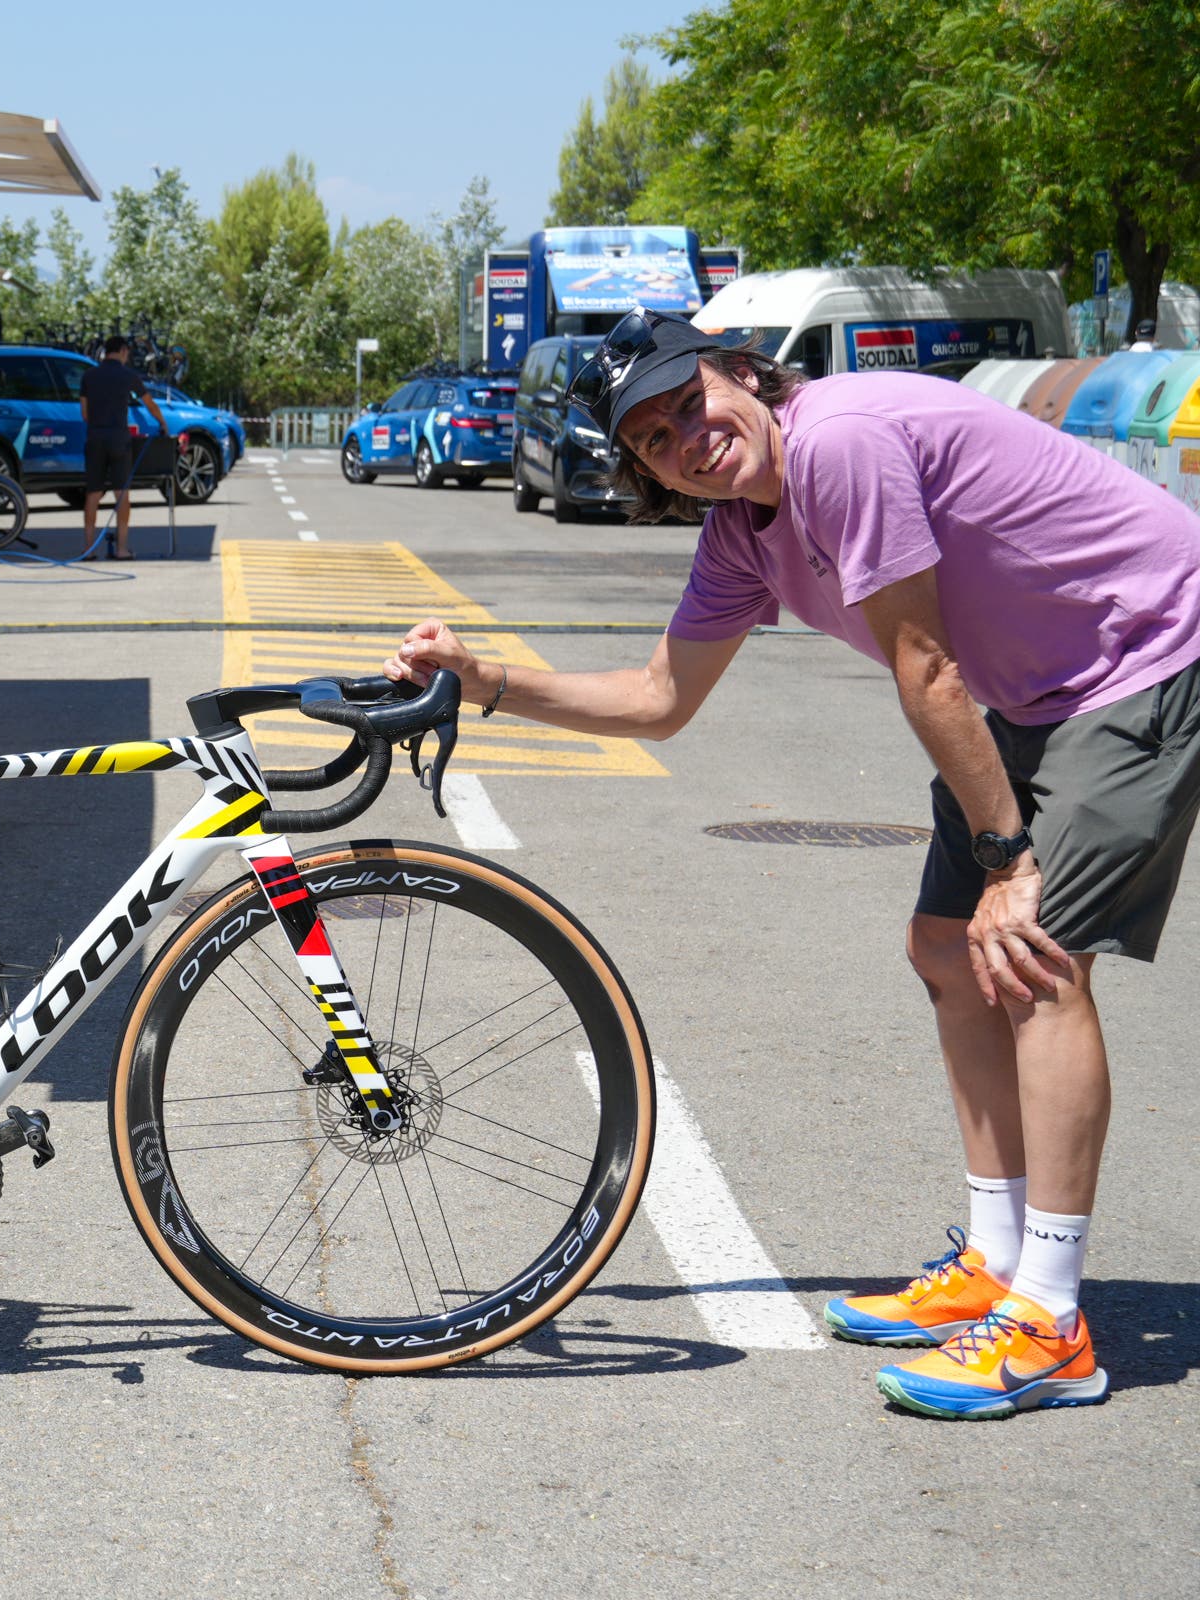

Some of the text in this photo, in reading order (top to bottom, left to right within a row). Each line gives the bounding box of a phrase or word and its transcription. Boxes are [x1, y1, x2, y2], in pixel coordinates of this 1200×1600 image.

[1096, 256, 1105, 287] P
[857, 347, 916, 369] SOUDAL
[1, 851, 185, 1073] LOOK
[179, 870, 461, 991] CAMPANOLO
[1024, 1224, 1082, 1243] OUVY
[267, 1206, 600, 1348] BORA ULTRA WTO
